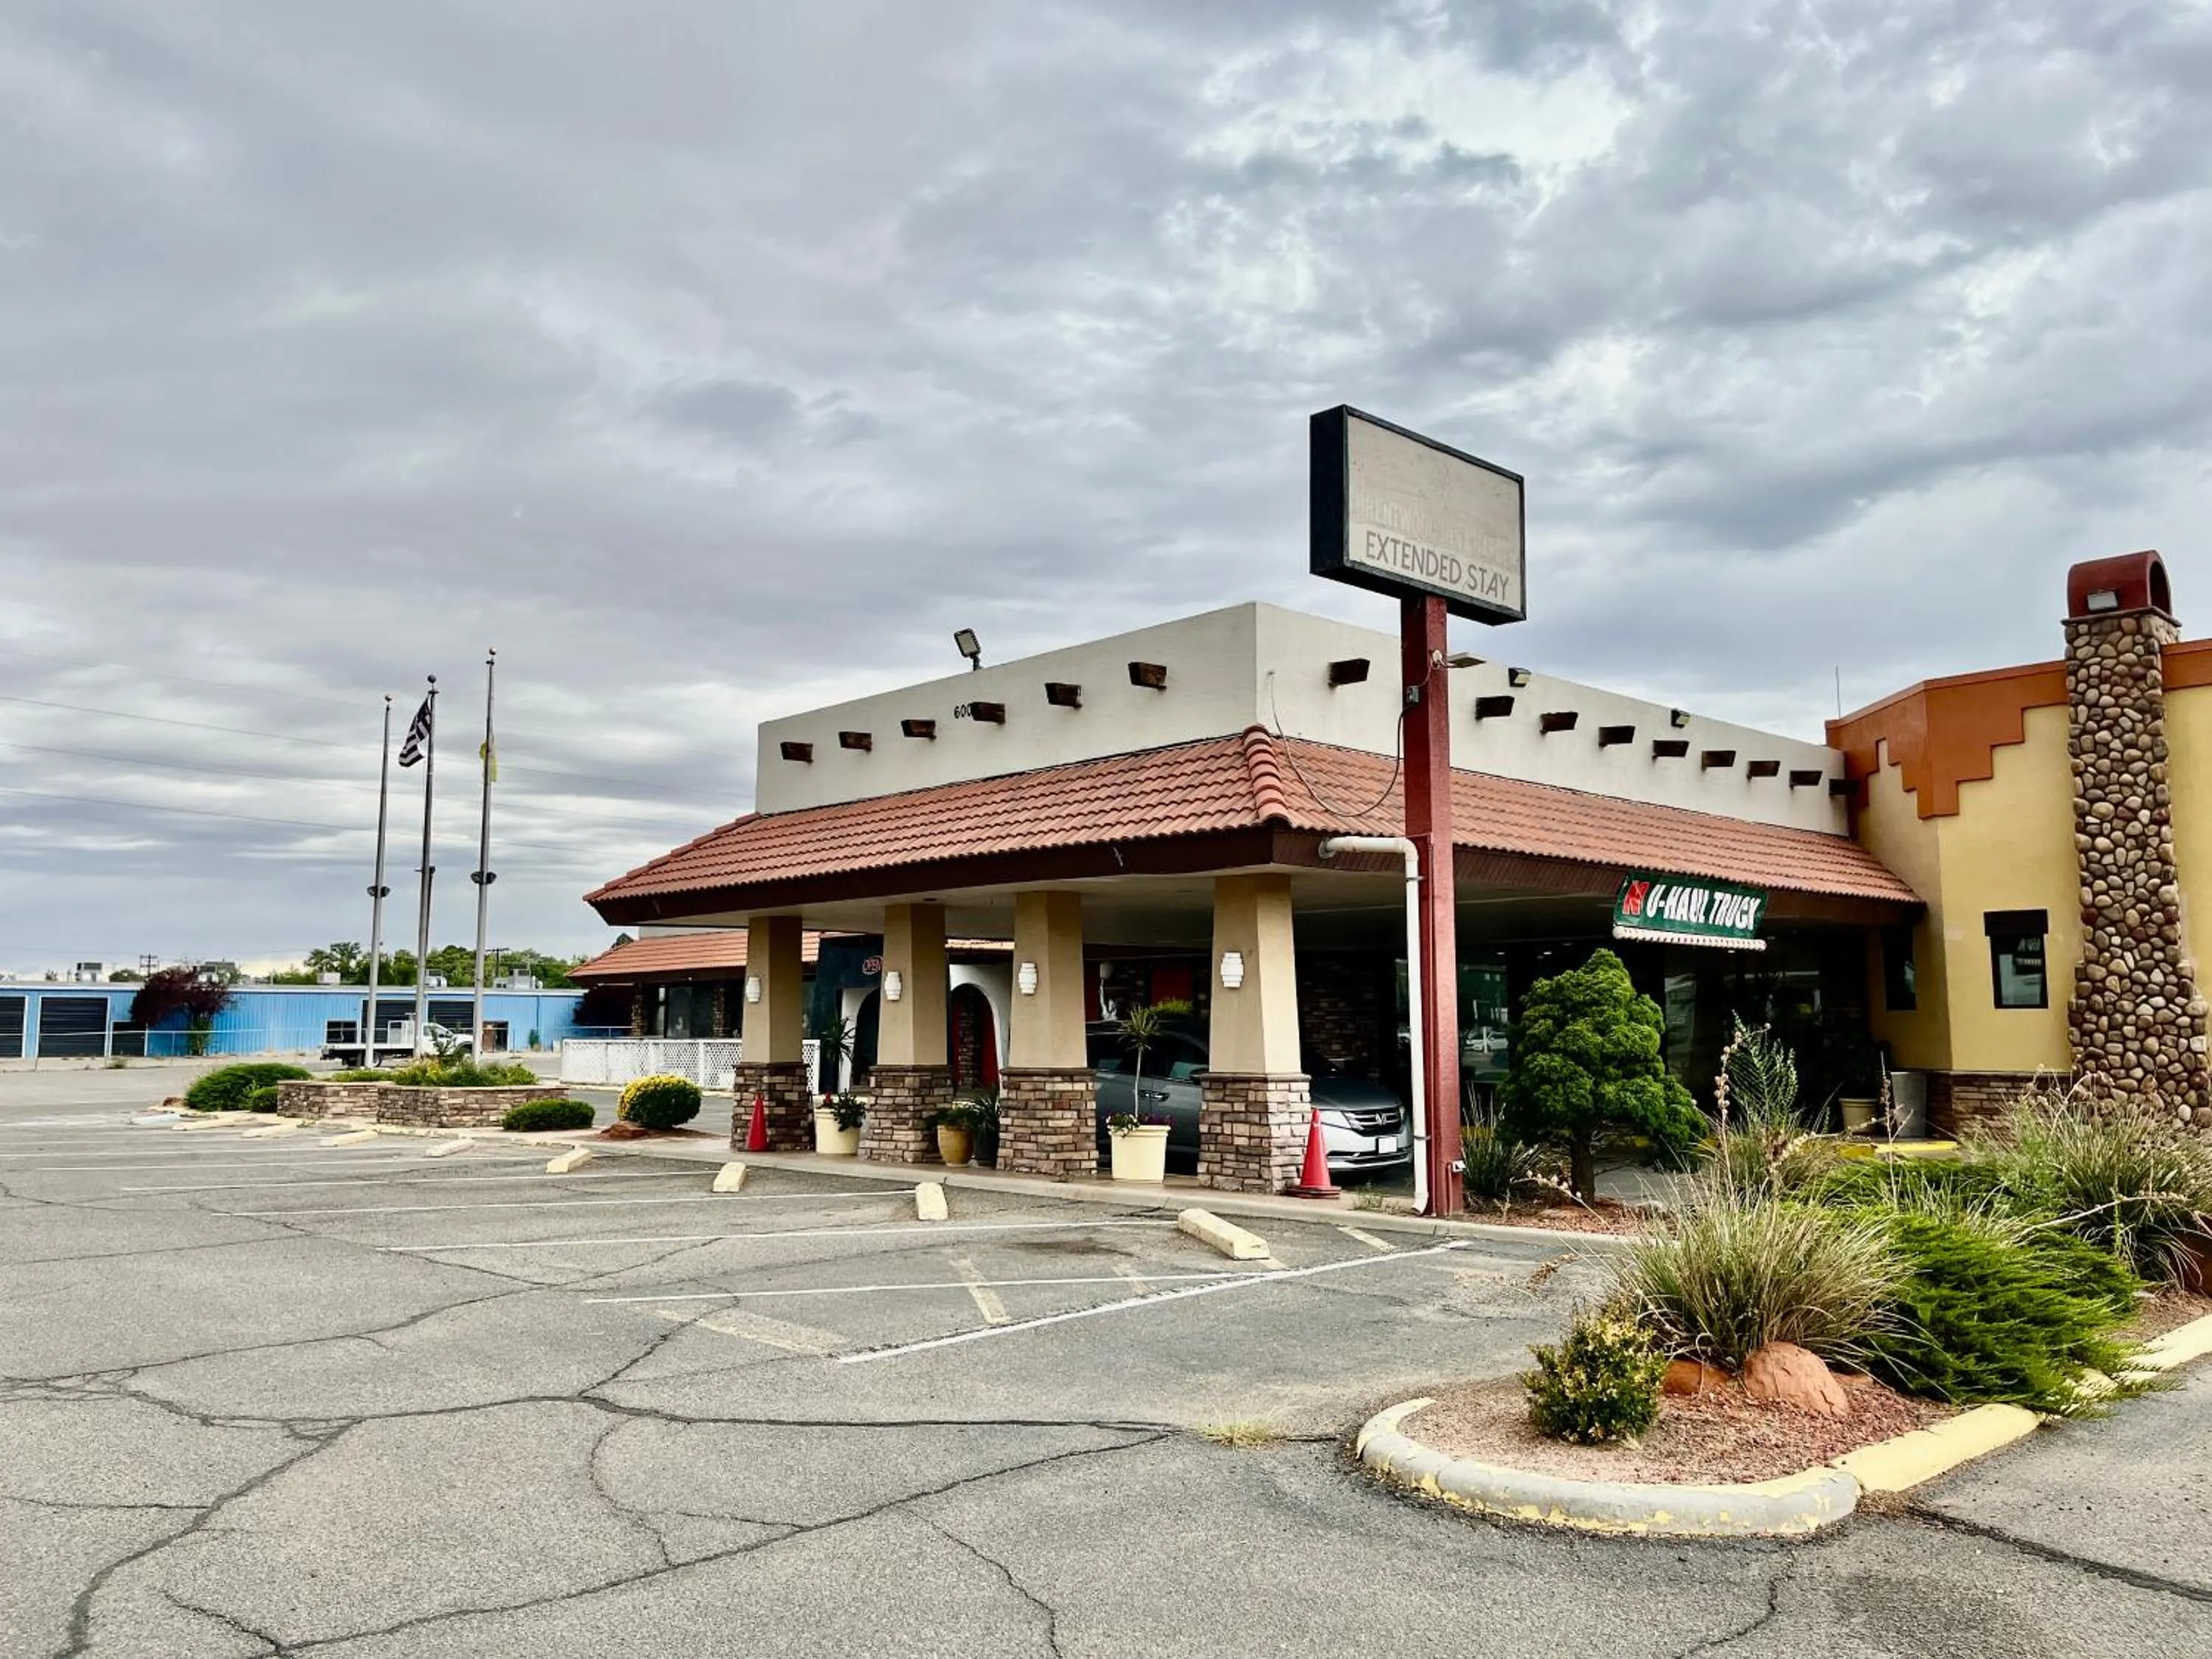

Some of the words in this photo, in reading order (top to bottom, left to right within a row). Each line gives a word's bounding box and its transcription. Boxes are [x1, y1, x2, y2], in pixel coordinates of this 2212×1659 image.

[1366, 530, 1461, 584] EXTENDED
[1467, 564, 1509, 600] STAY
[1646, 884, 1710, 924] U-HAUL
